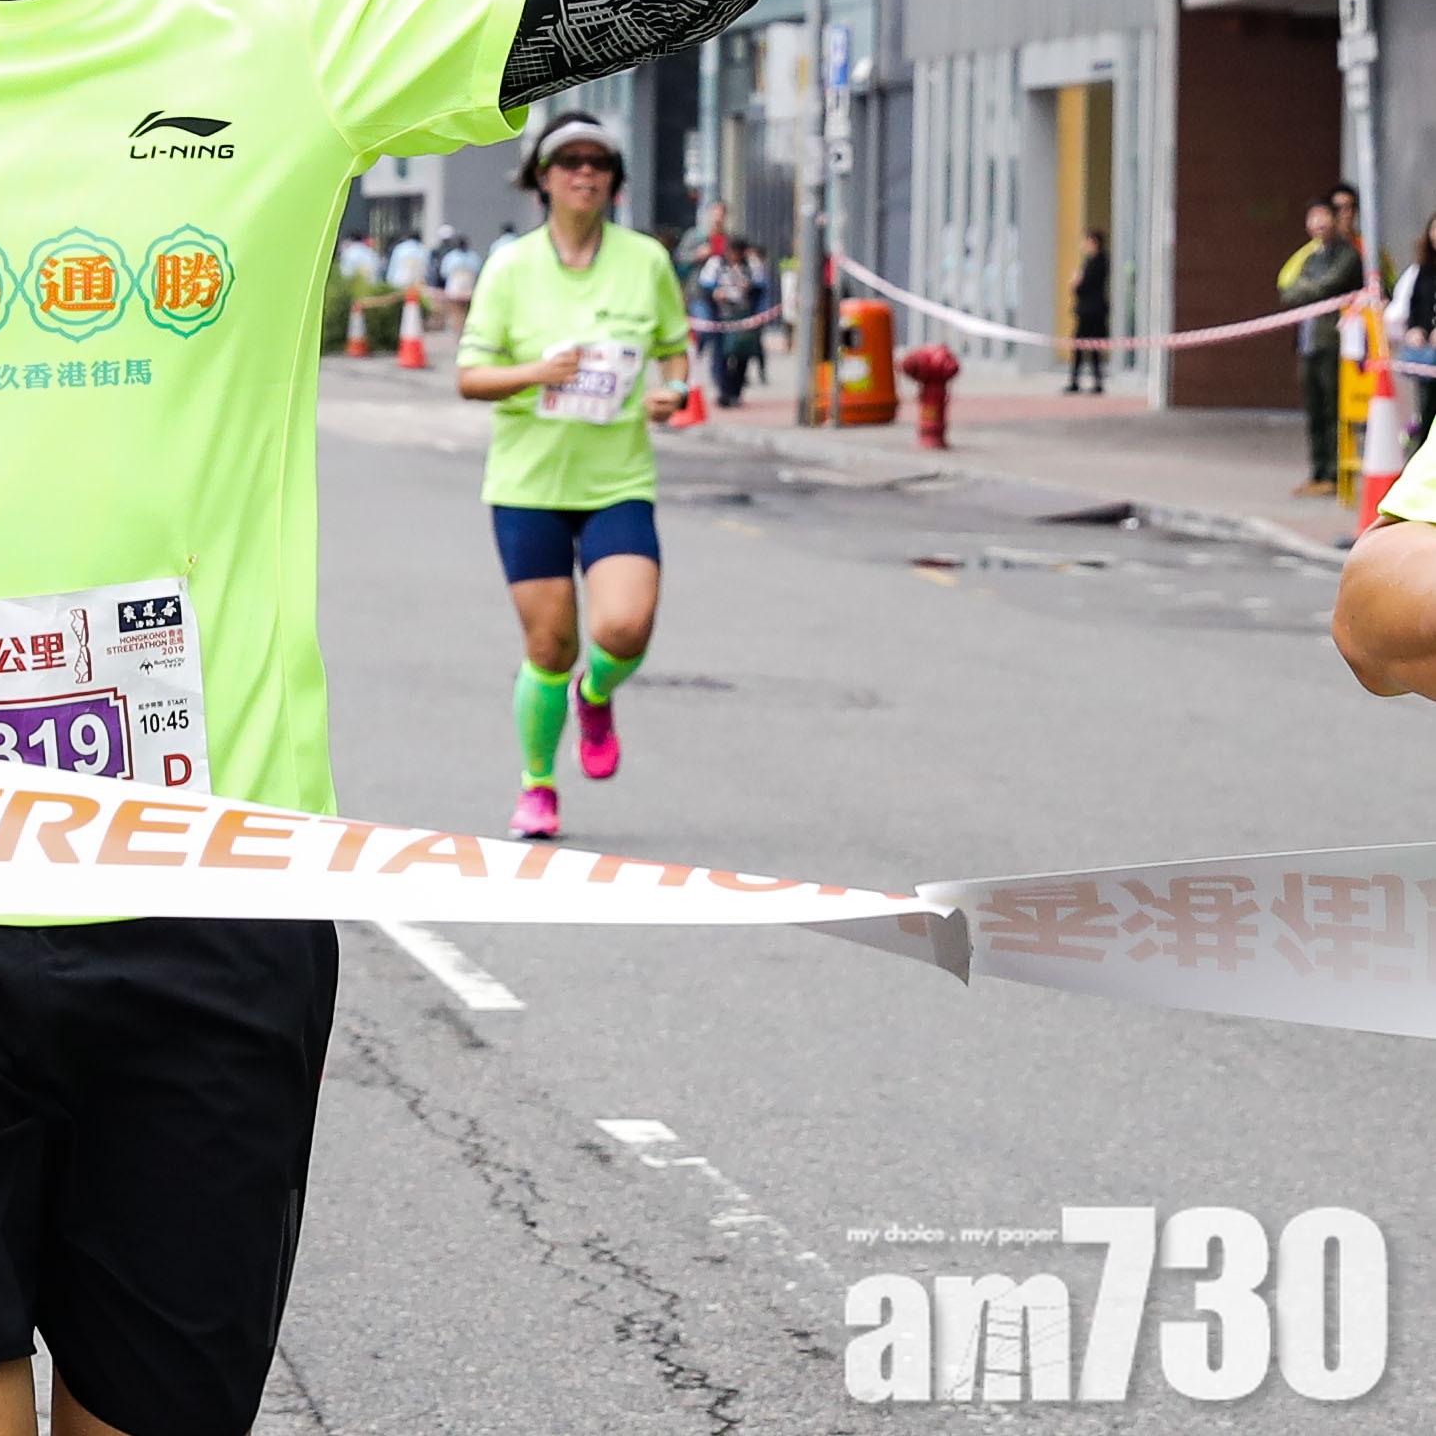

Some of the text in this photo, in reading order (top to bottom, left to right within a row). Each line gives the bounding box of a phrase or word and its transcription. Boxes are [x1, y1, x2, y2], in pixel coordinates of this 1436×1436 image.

[129, 144, 235, 160] LI-NING
[119, 630, 168, 644] HONGKONG
[106, 640, 168, 655] STREETATHON
[162, 645, 185, 656] 2019
[167, 697, 189, 707] START
[139, 709, 190, 735] 10:45
[163, 753, 193, 787] D
